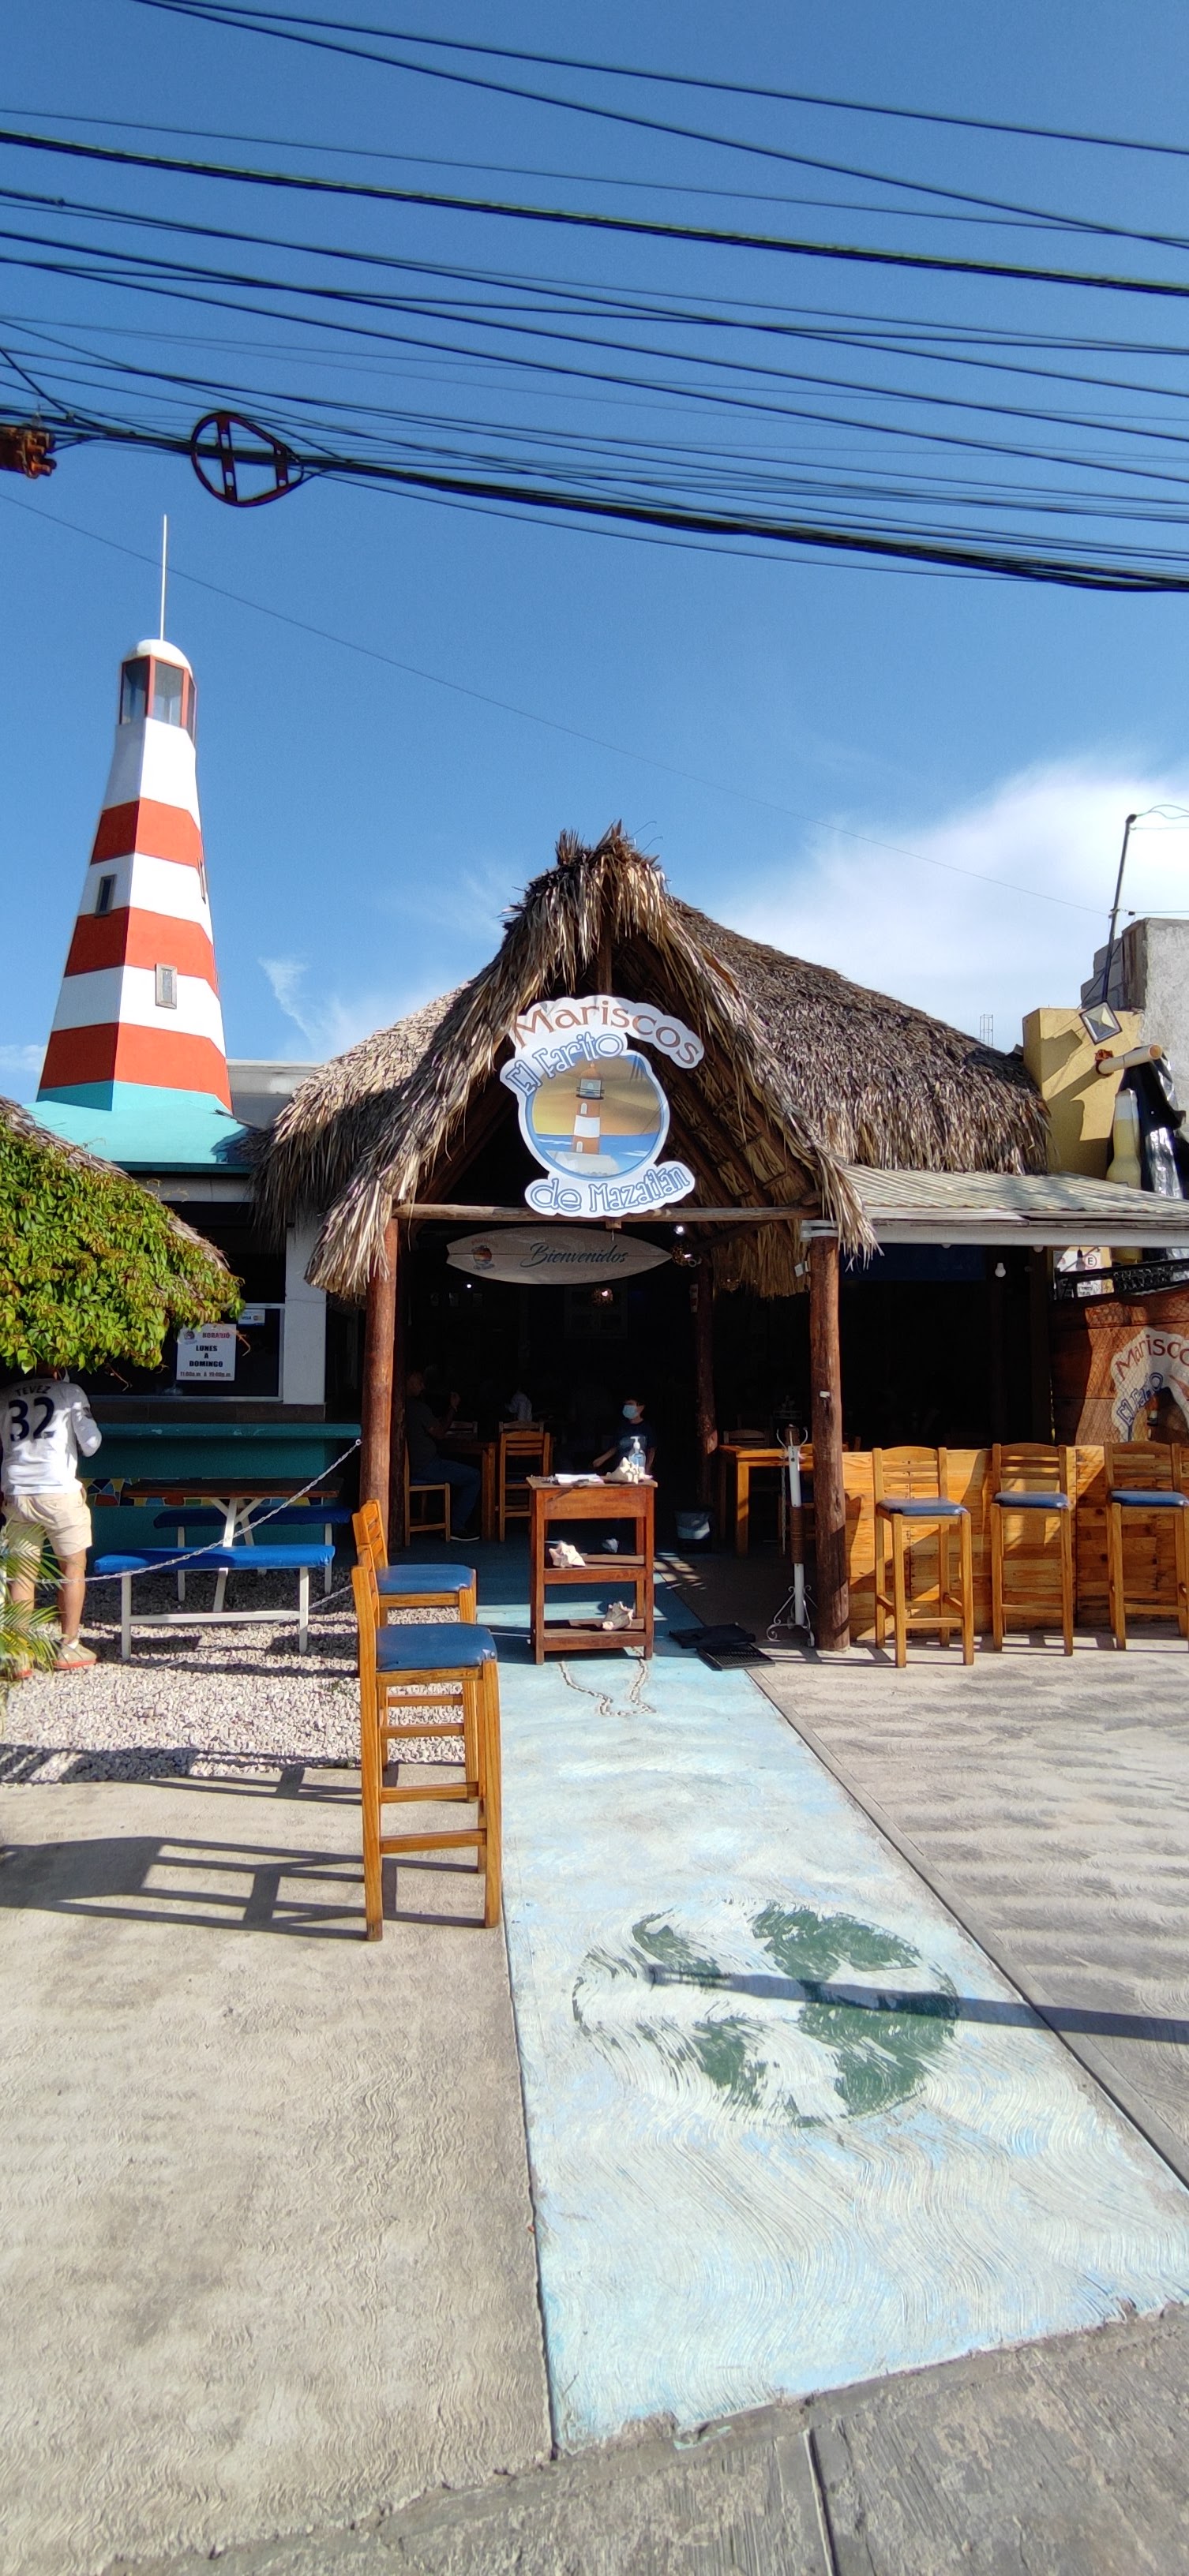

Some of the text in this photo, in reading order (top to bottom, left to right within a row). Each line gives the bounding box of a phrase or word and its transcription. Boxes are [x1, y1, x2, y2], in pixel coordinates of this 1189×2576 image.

[511, 1000, 700, 1065] Mariscos
[506, 1031, 624, 1097] El Farito
[530, 1166, 691, 1213] de Mazatlán
[519, 1241, 628, 1267] Bienvenidos
[1087, 1256, 1093, 1266] E
[16, 1385, 51, 1397] TEVEZ
[9, 1396, 56, 1442] 32
